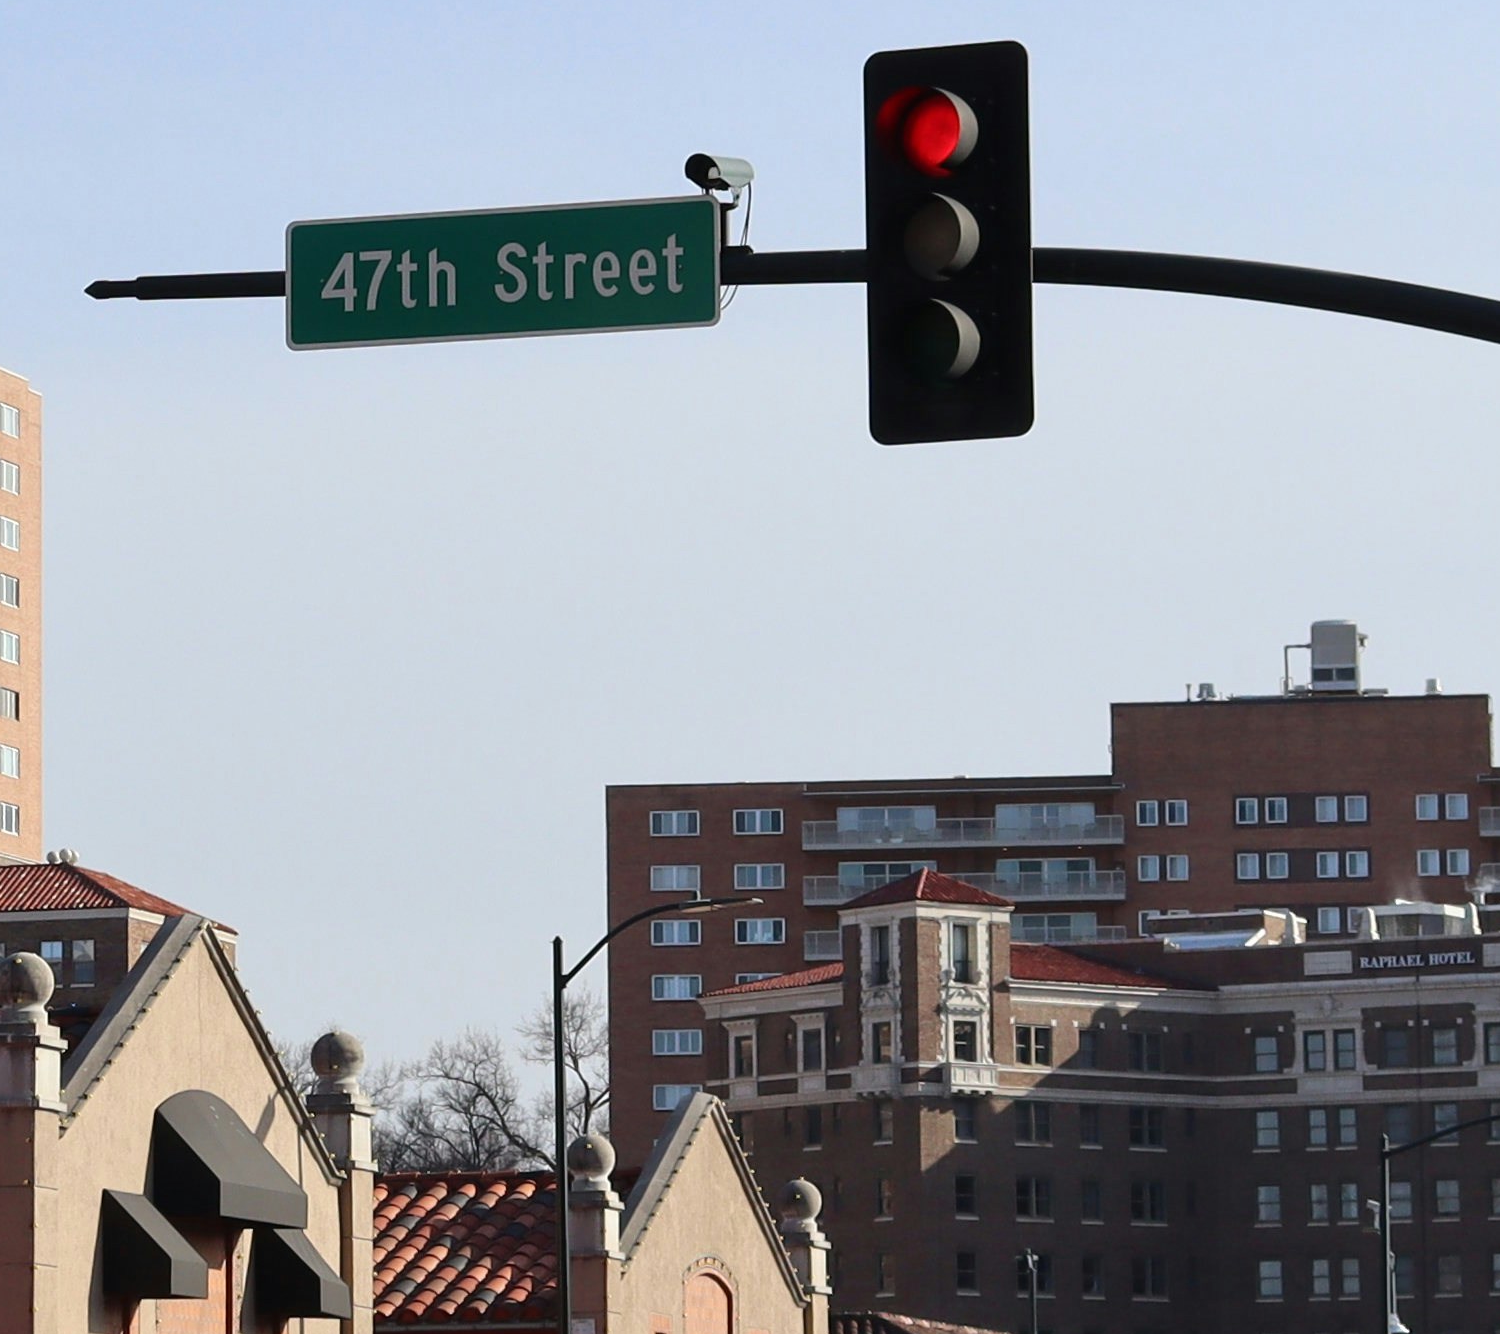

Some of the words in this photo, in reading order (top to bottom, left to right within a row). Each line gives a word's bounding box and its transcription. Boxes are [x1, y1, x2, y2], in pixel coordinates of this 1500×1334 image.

[321, 248, 456, 312] 47th
[494, 233, 685, 303] Street
[1359, 955, 1424, 969] RAPHAEL
[1428, 951, 1475, 966] HOTEL
